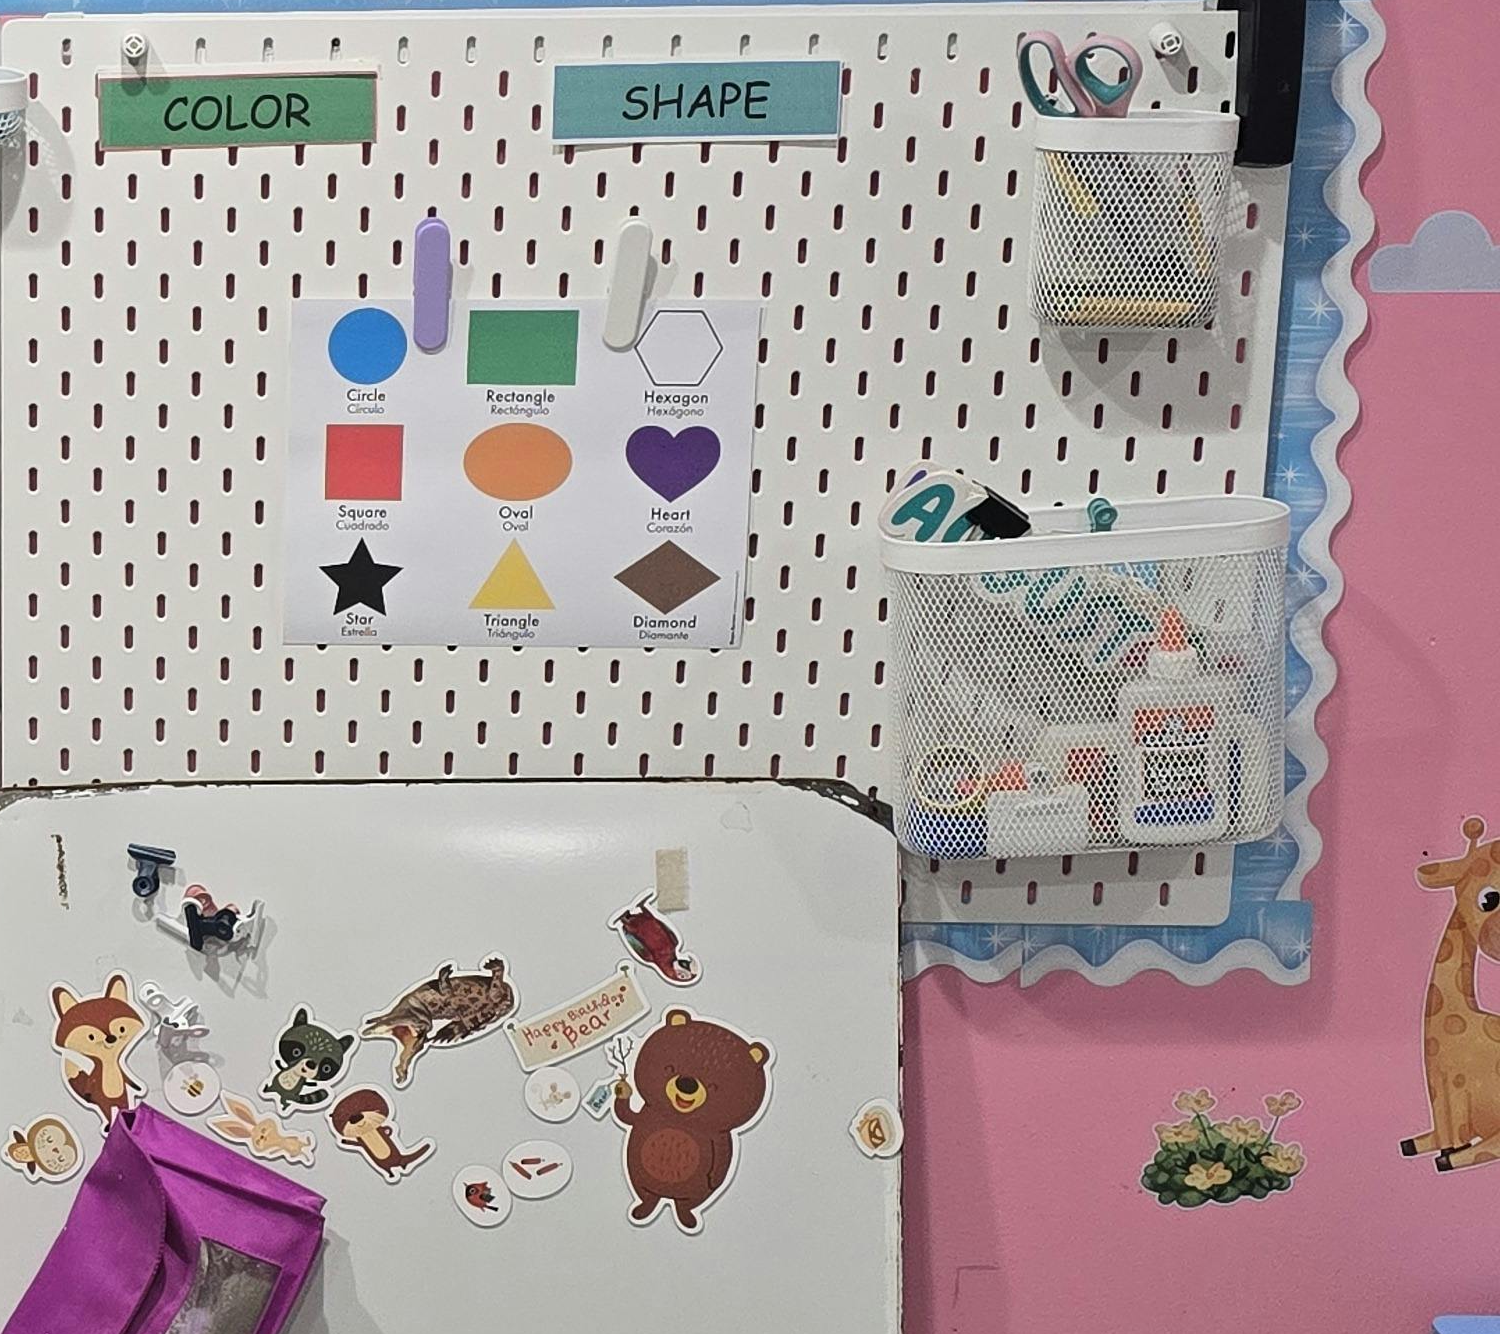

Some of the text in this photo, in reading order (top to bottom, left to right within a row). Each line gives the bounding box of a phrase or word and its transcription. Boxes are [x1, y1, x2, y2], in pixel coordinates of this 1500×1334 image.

[622, 80, 773, 122] SHAPE
[163, 93, 313, 133] COLOR
[346, 388, 386, 403] Circle
[486, 388, 555, 406] Rectangle
[643, 390, 709, 408] Hexagon
[337, 505, 388, 522] Square
[498, 505, 534, 520] Oval
[650, 507, 691, 522] Heart
[335, 519, 390, 532] Cuadrado
[501, 520, 530, 532] Oval
[345, 612, 374, 627] Star
[483, 613, 540, 629] Triangle
[632, 615, 697, 630] Diamond
[638, 629, 690, 641] Diamante
[521, 1018, 567, 1048] Happy
[561, 1010, 611, 1050] Bear
